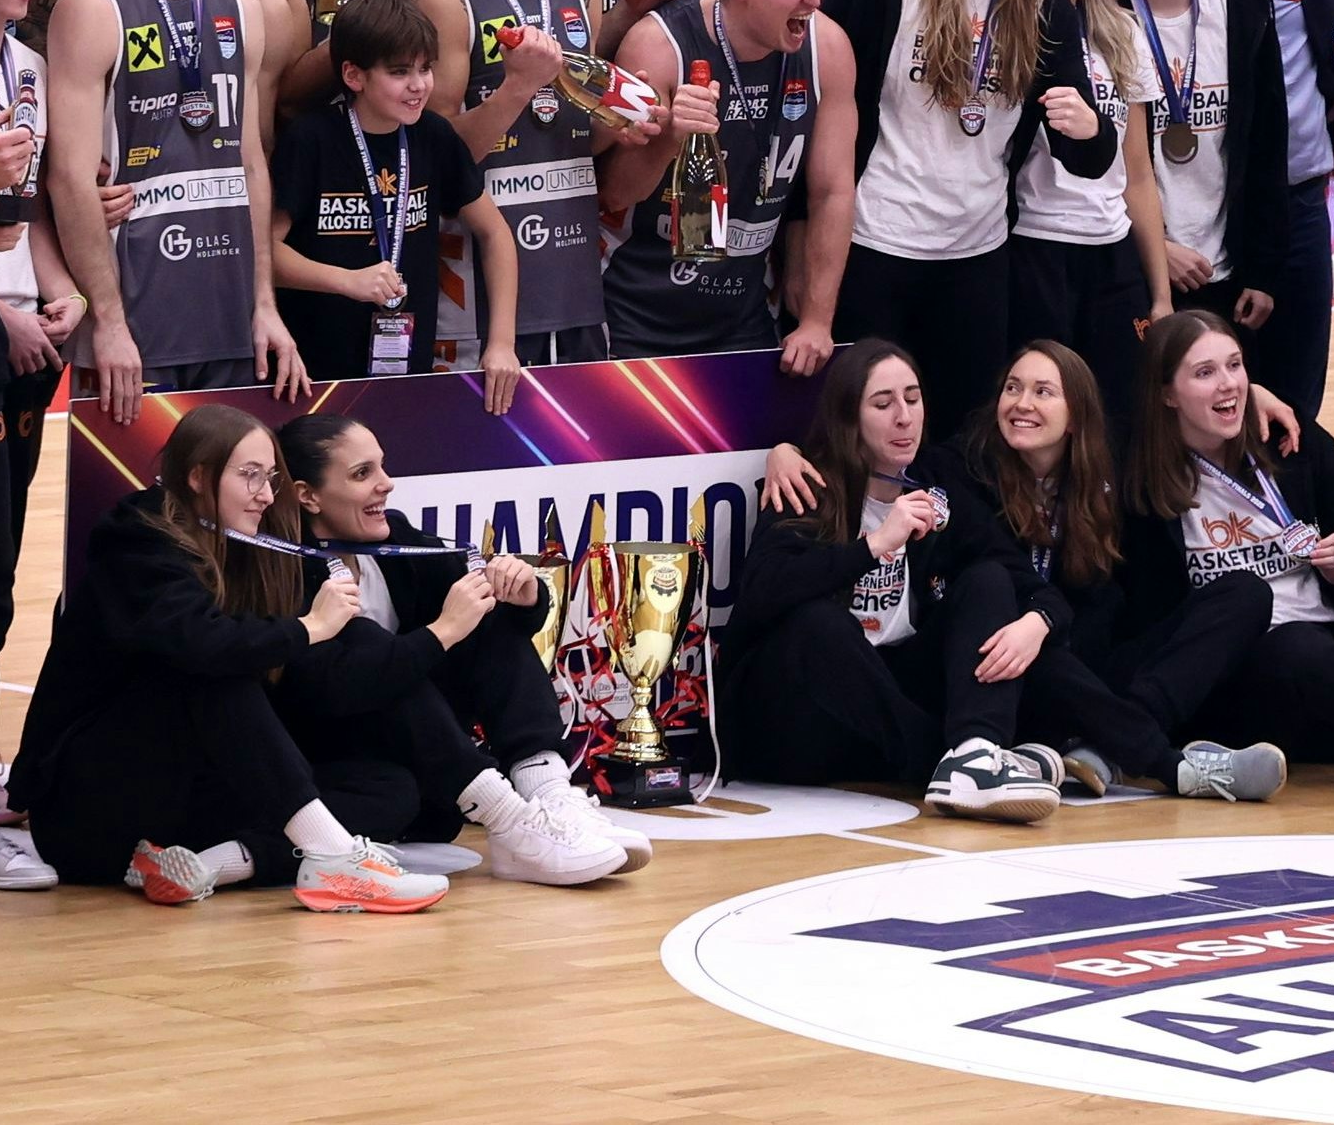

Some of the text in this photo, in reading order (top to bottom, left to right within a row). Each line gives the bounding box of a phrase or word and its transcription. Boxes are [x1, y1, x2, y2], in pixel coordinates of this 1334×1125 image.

[129, 93, 178, 115] tipico
[190, 178, 245, 200] UNITED
[491, 174, 545, 196] IMMO
[549, 167, 595, 189] UNITED
[319, 188, 427, 216] BASKTALL
[196, 234, 231, 249] GLAS
[554, 223, 583, 239] GLAS
[1201, 510, 1261, 549] bk
